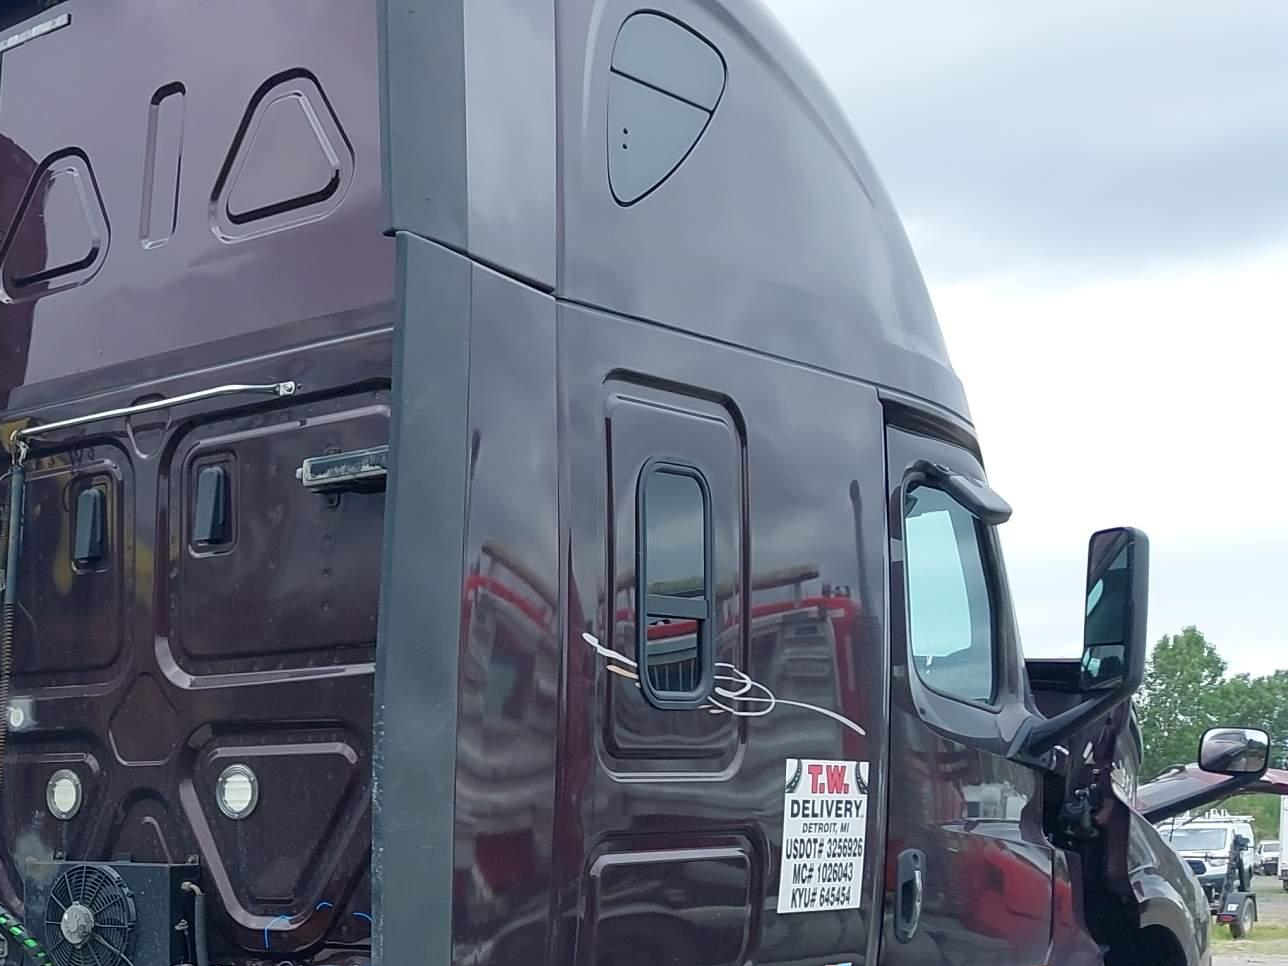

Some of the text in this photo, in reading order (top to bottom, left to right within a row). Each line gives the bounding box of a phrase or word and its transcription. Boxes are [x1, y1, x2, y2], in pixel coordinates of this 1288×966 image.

[807, 764, 850, 795] T.W.
[790, 799, 863, 818] DELIVERY
[802, 822, 850, 834] DETROIT, MI
[785, 837, 863, 860] USDOT# 3256926
[792, 862, 854, 885] MC# 1026043
[791, 886, 852, 909] KYU# 645454
